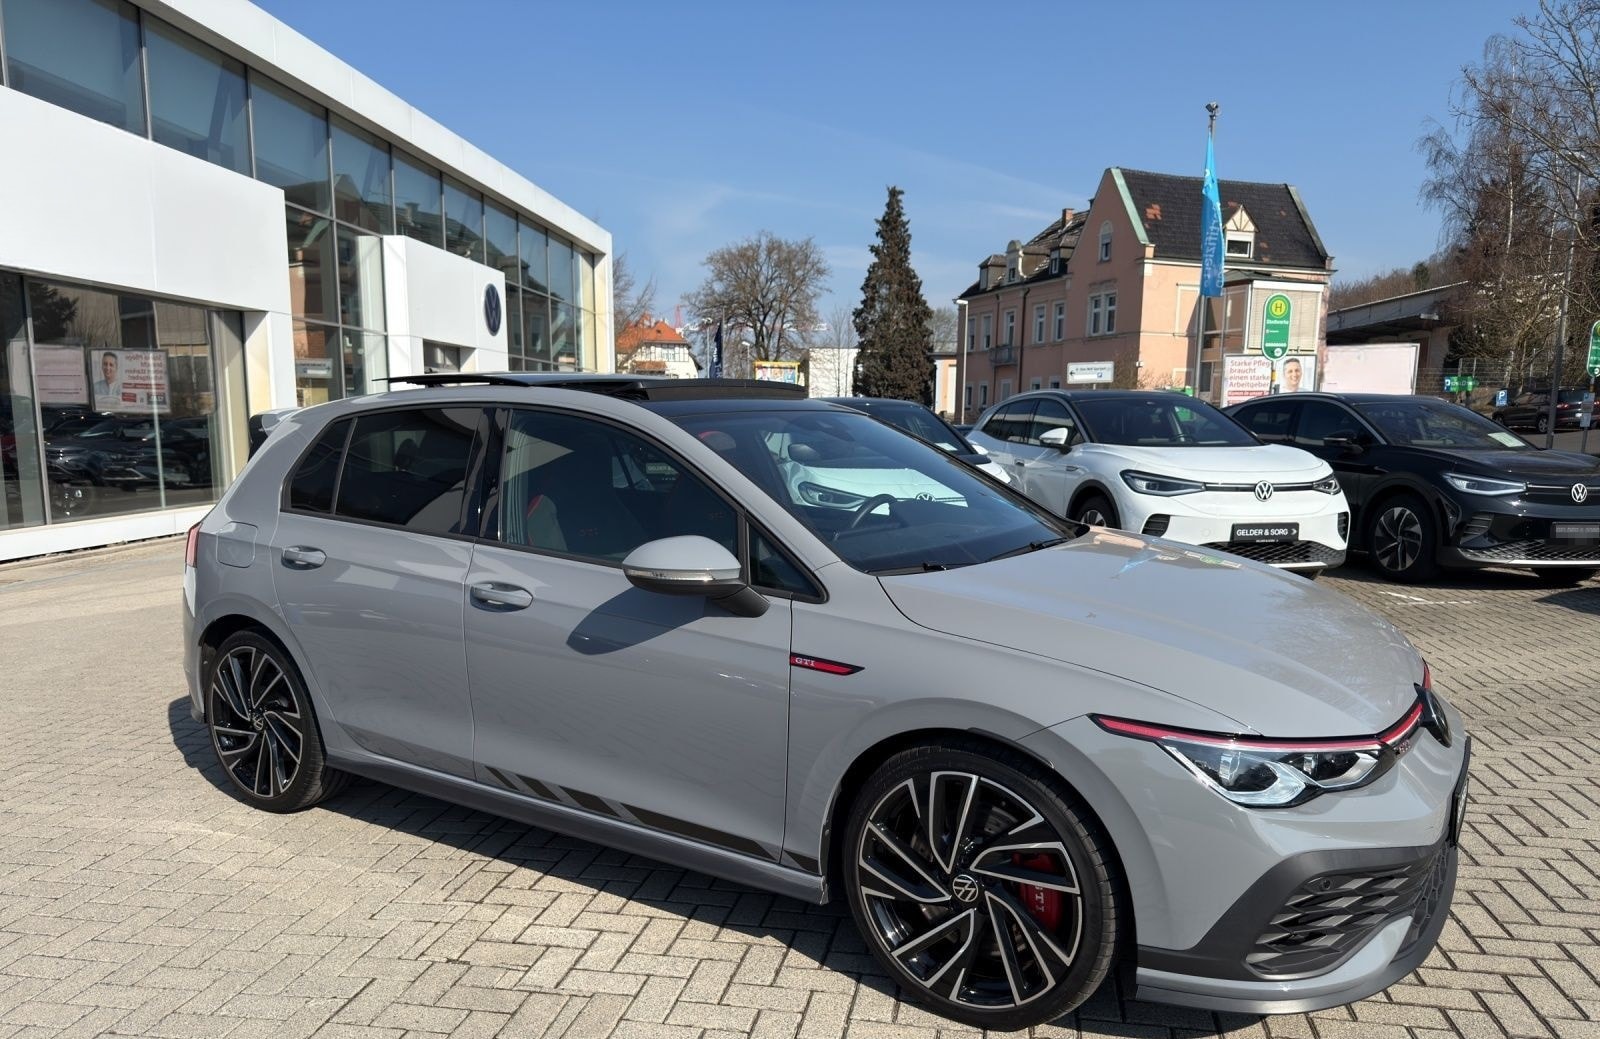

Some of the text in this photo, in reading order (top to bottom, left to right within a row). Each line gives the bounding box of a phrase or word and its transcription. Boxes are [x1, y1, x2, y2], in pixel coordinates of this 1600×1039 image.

[1275, 302, 1283, 313] H
[1253, 360, 1270, 369] Pfleg
[1255, 480, 1274, 502] VW
[1571, 483, 1588, 503] VW
[795, 657, 816, 667] GTI
